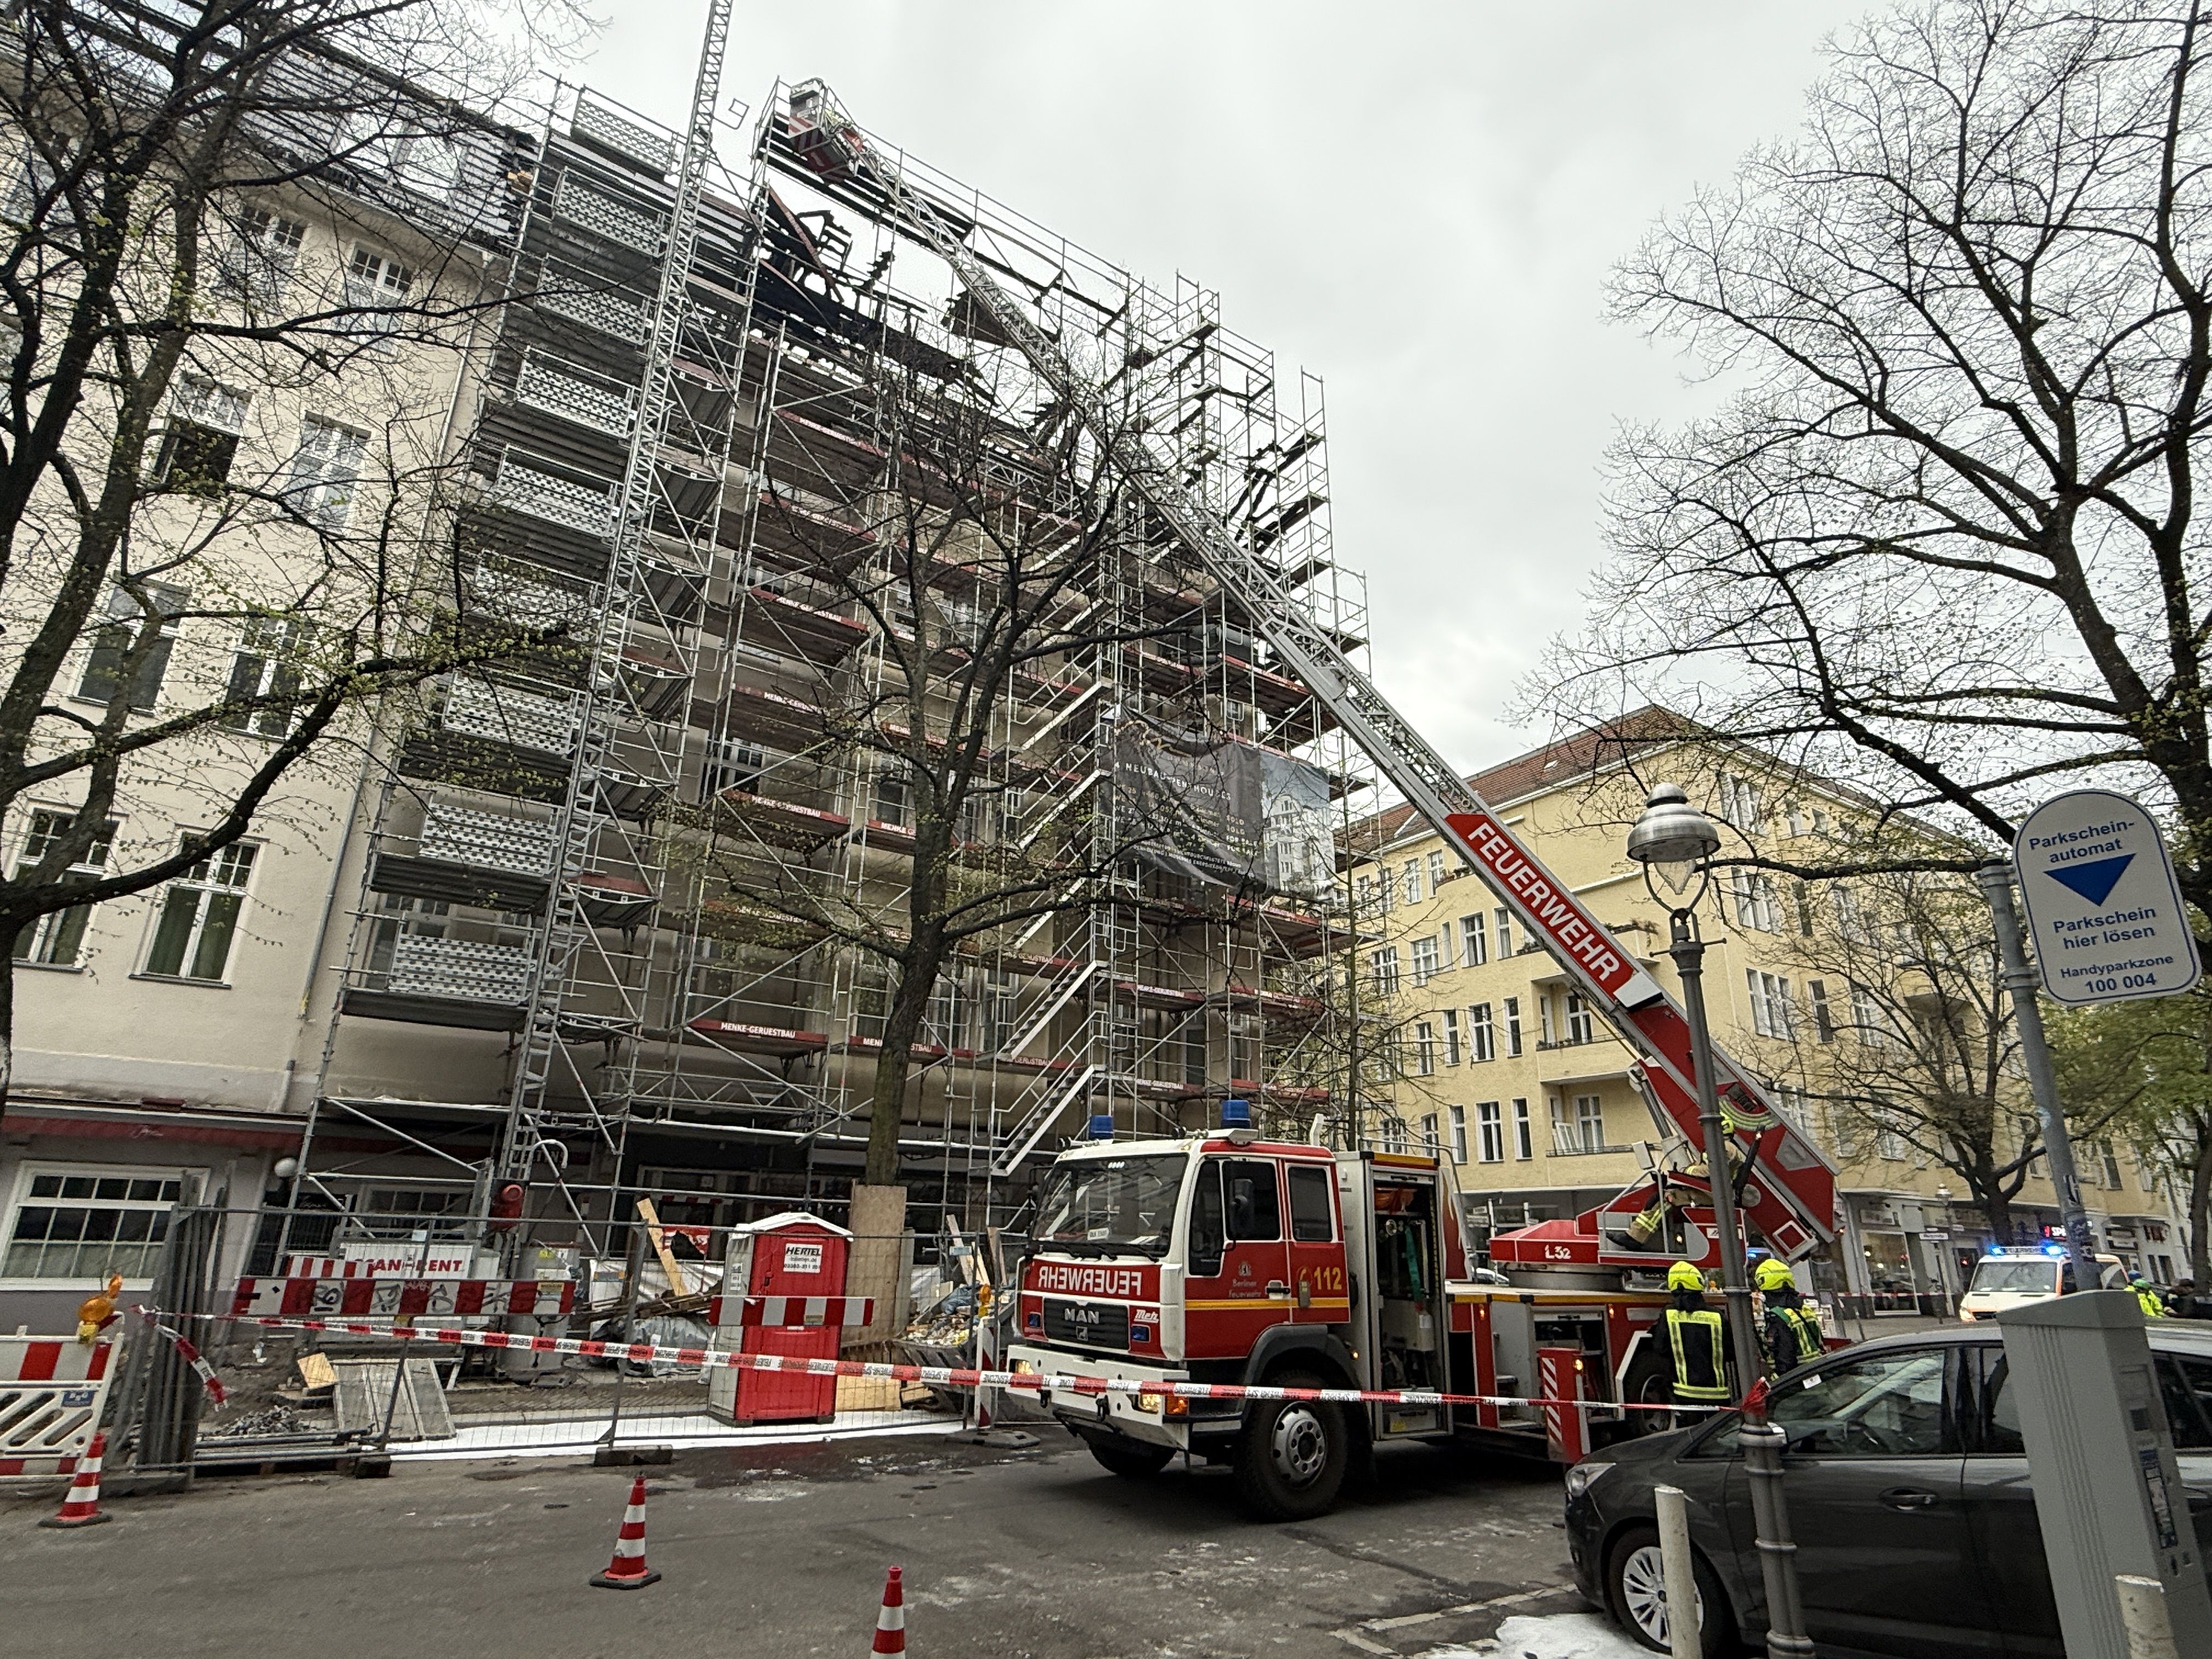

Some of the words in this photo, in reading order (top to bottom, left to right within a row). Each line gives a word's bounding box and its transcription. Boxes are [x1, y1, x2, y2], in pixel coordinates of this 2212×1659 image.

[2029, 820, 2135, 851] Parkschein-
[2050, 838, 2124, 863] automat
[1468, 822, 1621, 983] FEUERWEHR
[2052, 907, 2157, 934] Parkschein
[2063, 934, 2098, 950] hier
[2103, 926, 2155, 943] lösen
[2061, 955, 2174, 979] Handyparkzone
[2085, 977, 2118, 994] 100
[2123, 971, 2157, 989] 004
[721, 1022, 796, 1039] MENKE-GERUESTBAU
[786, 1246, 821, 1256] HERTEL
[1232, 1278, 1257, 1288] Berliner
[1313, 1266, 1342, 1290] 112
[1064, 1308, 1099, 1324] MAN
